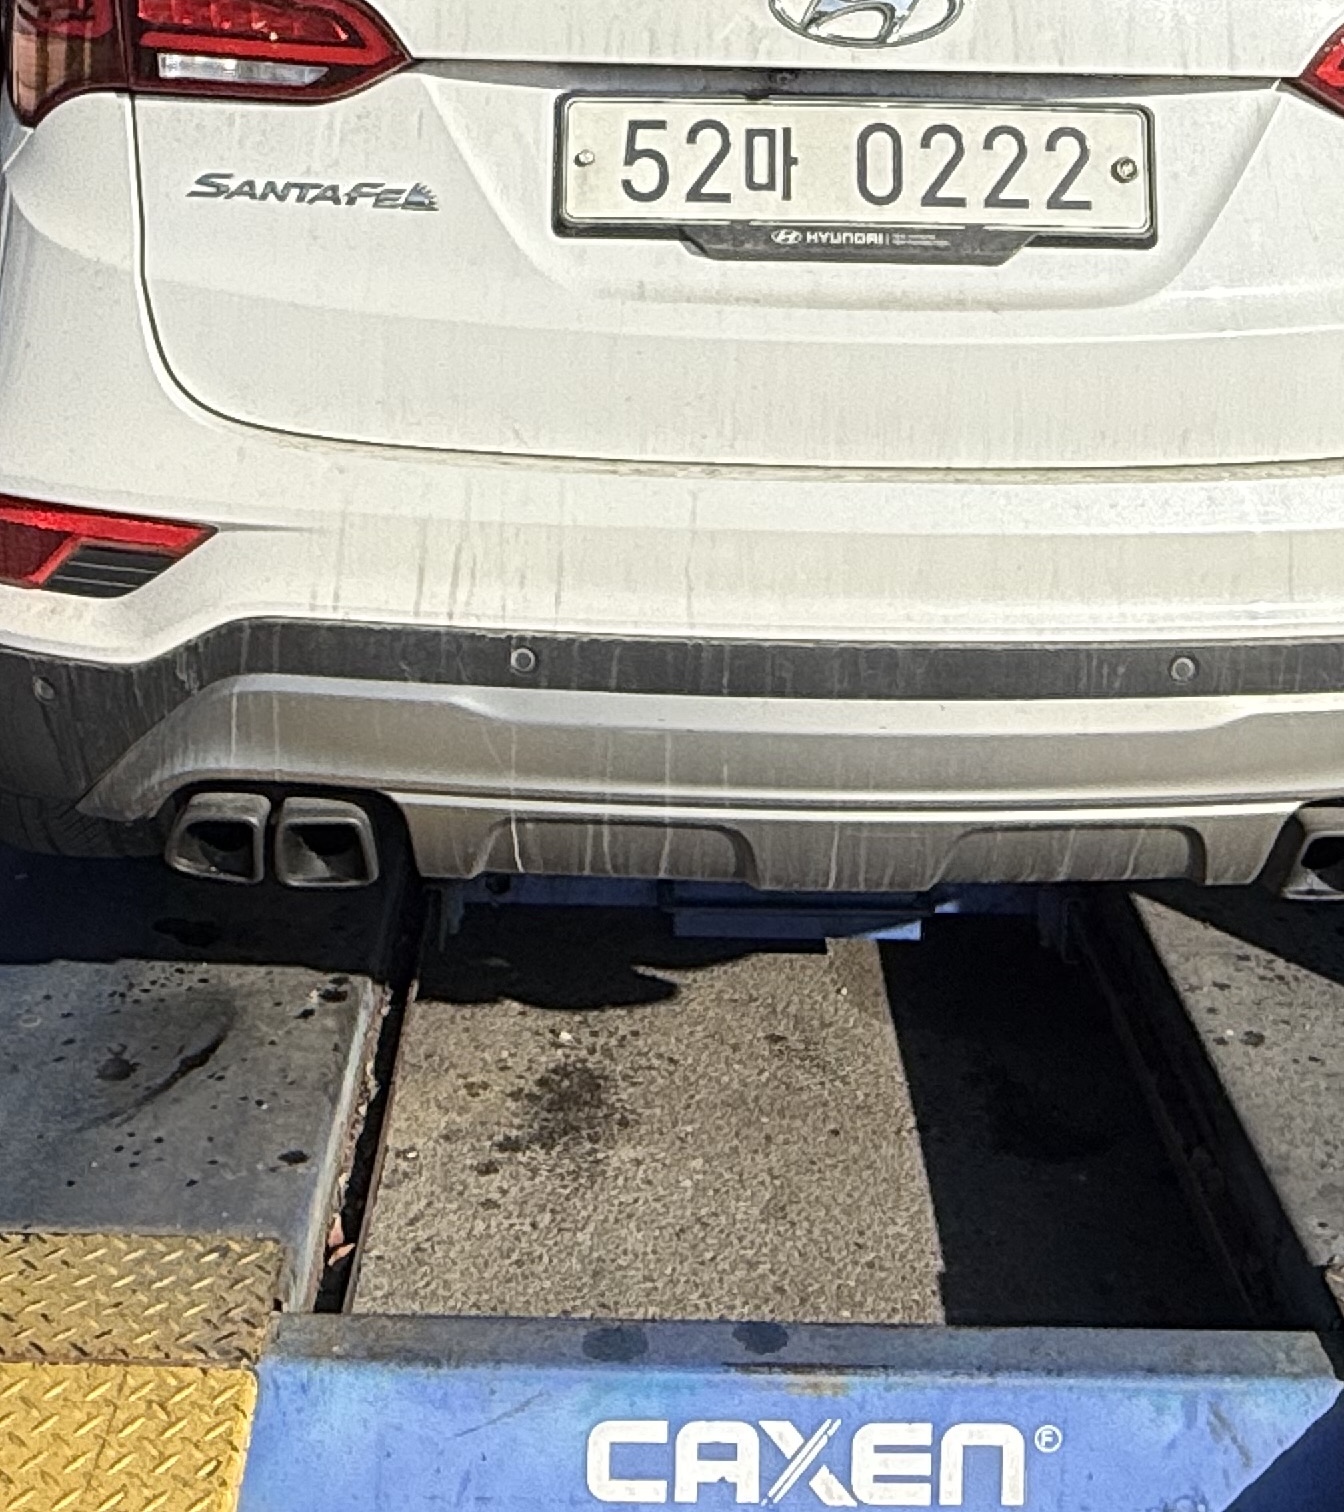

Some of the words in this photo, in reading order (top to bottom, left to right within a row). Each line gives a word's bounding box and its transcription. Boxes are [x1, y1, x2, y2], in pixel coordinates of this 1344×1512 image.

[620, 118, 798, 203] 52마
[855, 122, 1093, 211] 0222
[806, 231, 884, 245] HYUNDAI
